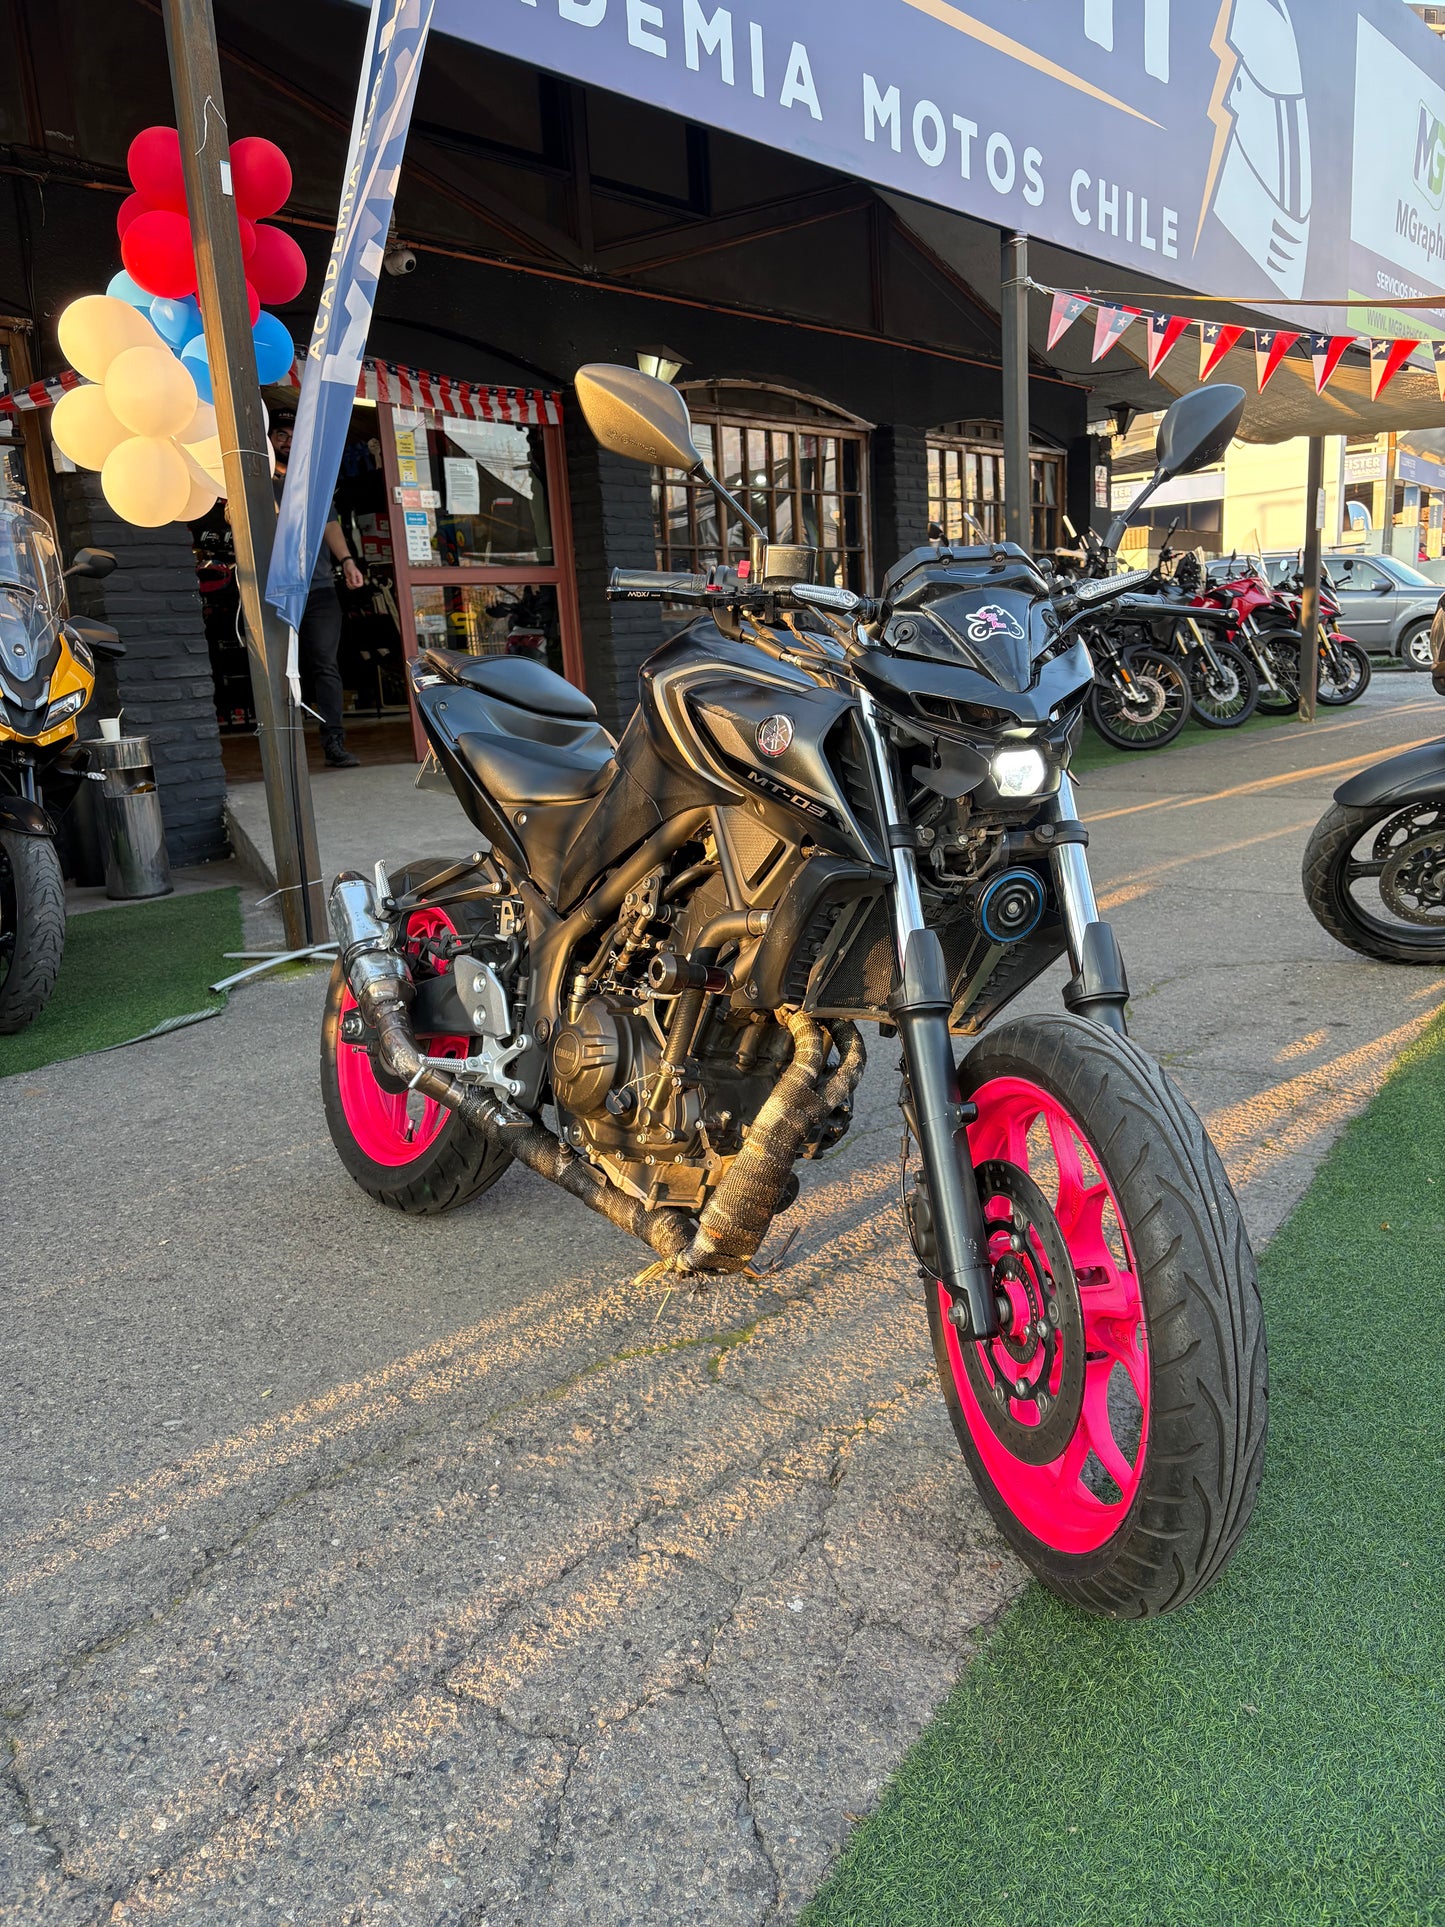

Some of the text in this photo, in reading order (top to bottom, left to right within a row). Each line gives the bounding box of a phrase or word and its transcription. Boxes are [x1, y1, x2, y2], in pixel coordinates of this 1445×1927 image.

[520, 0, 823, 121] EMIA
[863, 73, 1045, 206] MOTOS
[1070, 168, 1179, 260] CHILE
[309, 163, 360, 361] ACADEMIA
[1376, 270, 1408, 299] SERVICIOS
[747, 771, 828, 818] MT-03
